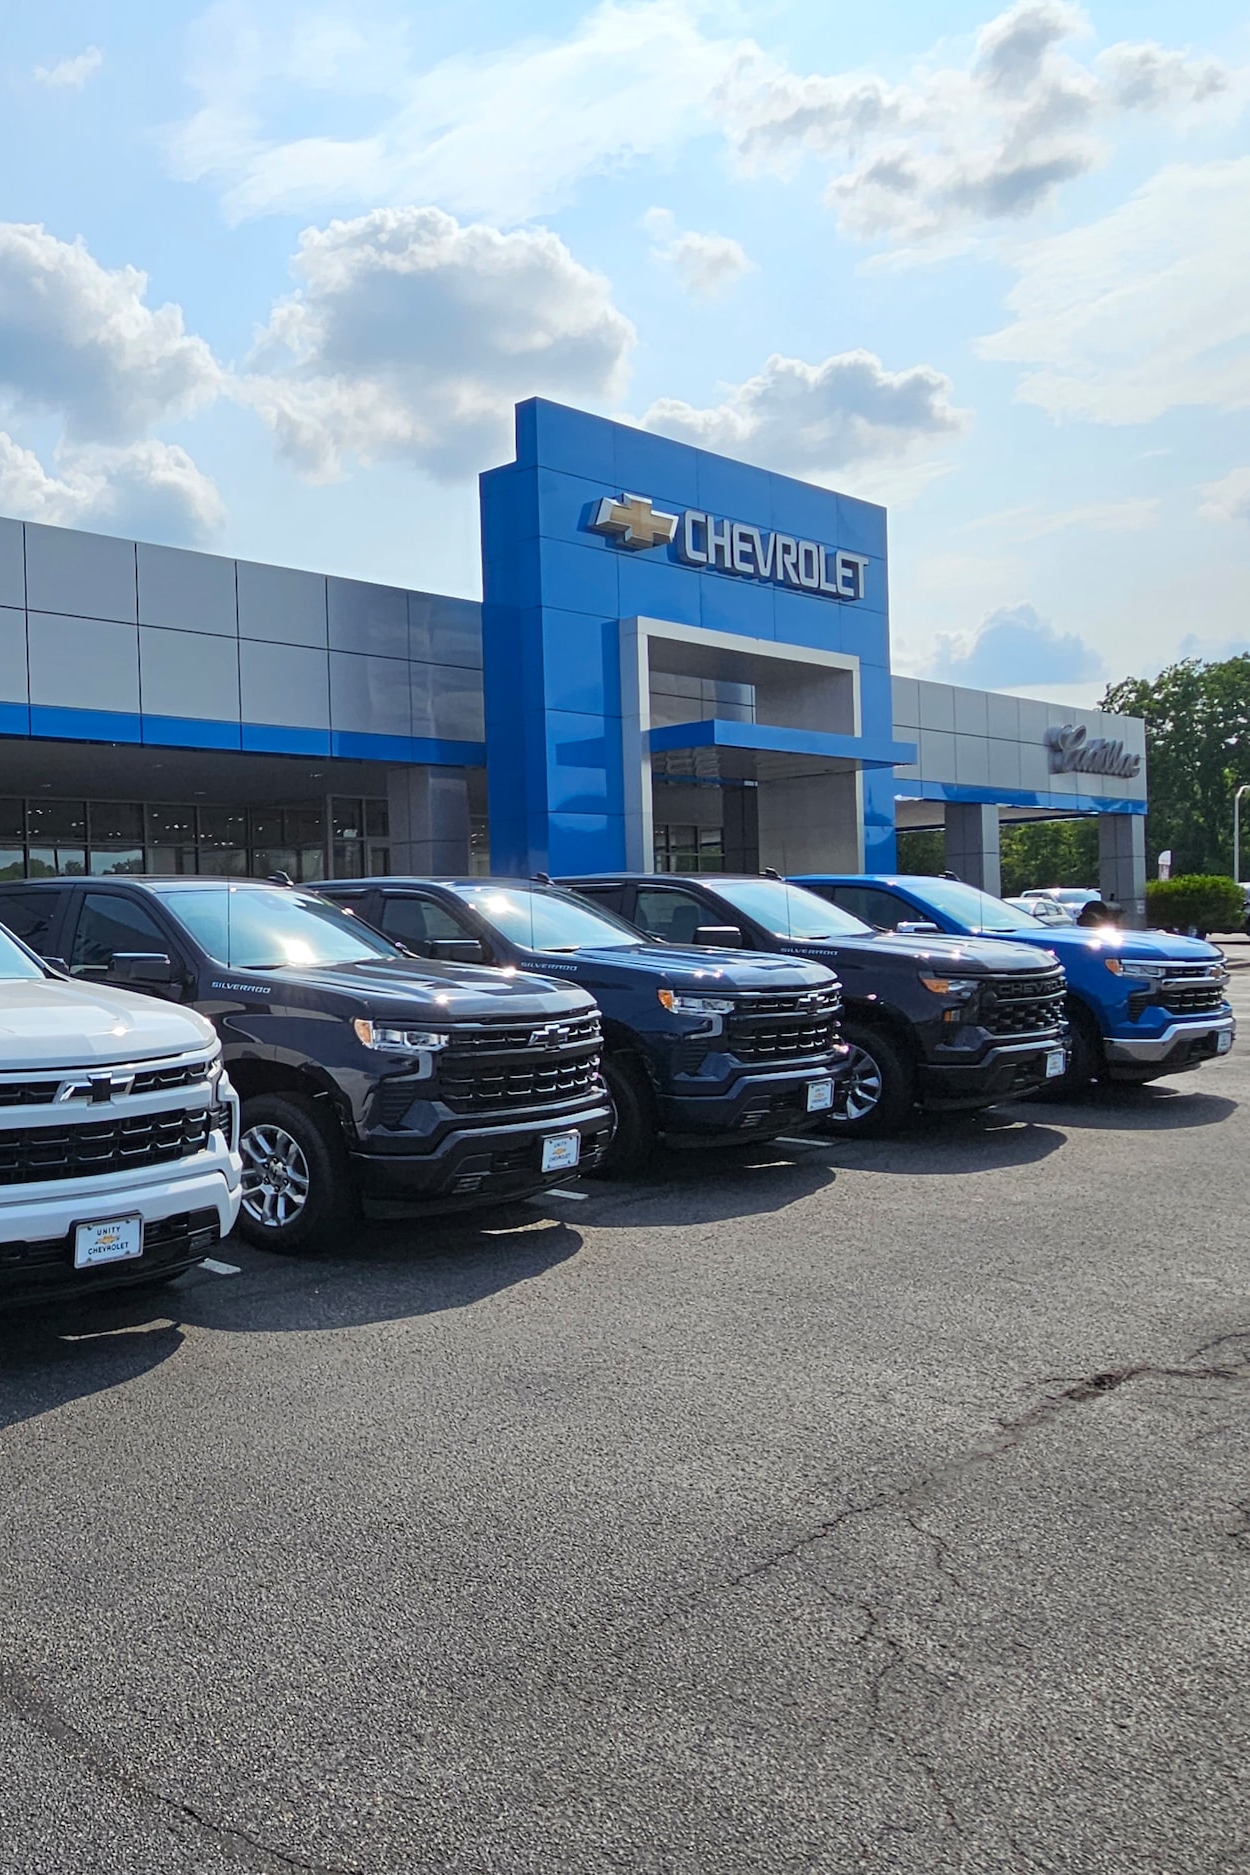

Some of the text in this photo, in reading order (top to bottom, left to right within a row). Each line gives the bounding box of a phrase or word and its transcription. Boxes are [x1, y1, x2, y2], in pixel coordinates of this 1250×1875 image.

[682, 509, 869, 600] CHEVROLET
[1052, 724, 1140, 779] Cadillac
[520, 961, 578, 972] SILVERADO
[211, 981, 271, 994] SILVERADO
[998, 980, 1066, 995] CHEVRO
[96, 1225, 121, 1236] UNITY
[87, 1241, 129, 1255] CHEVROLET
